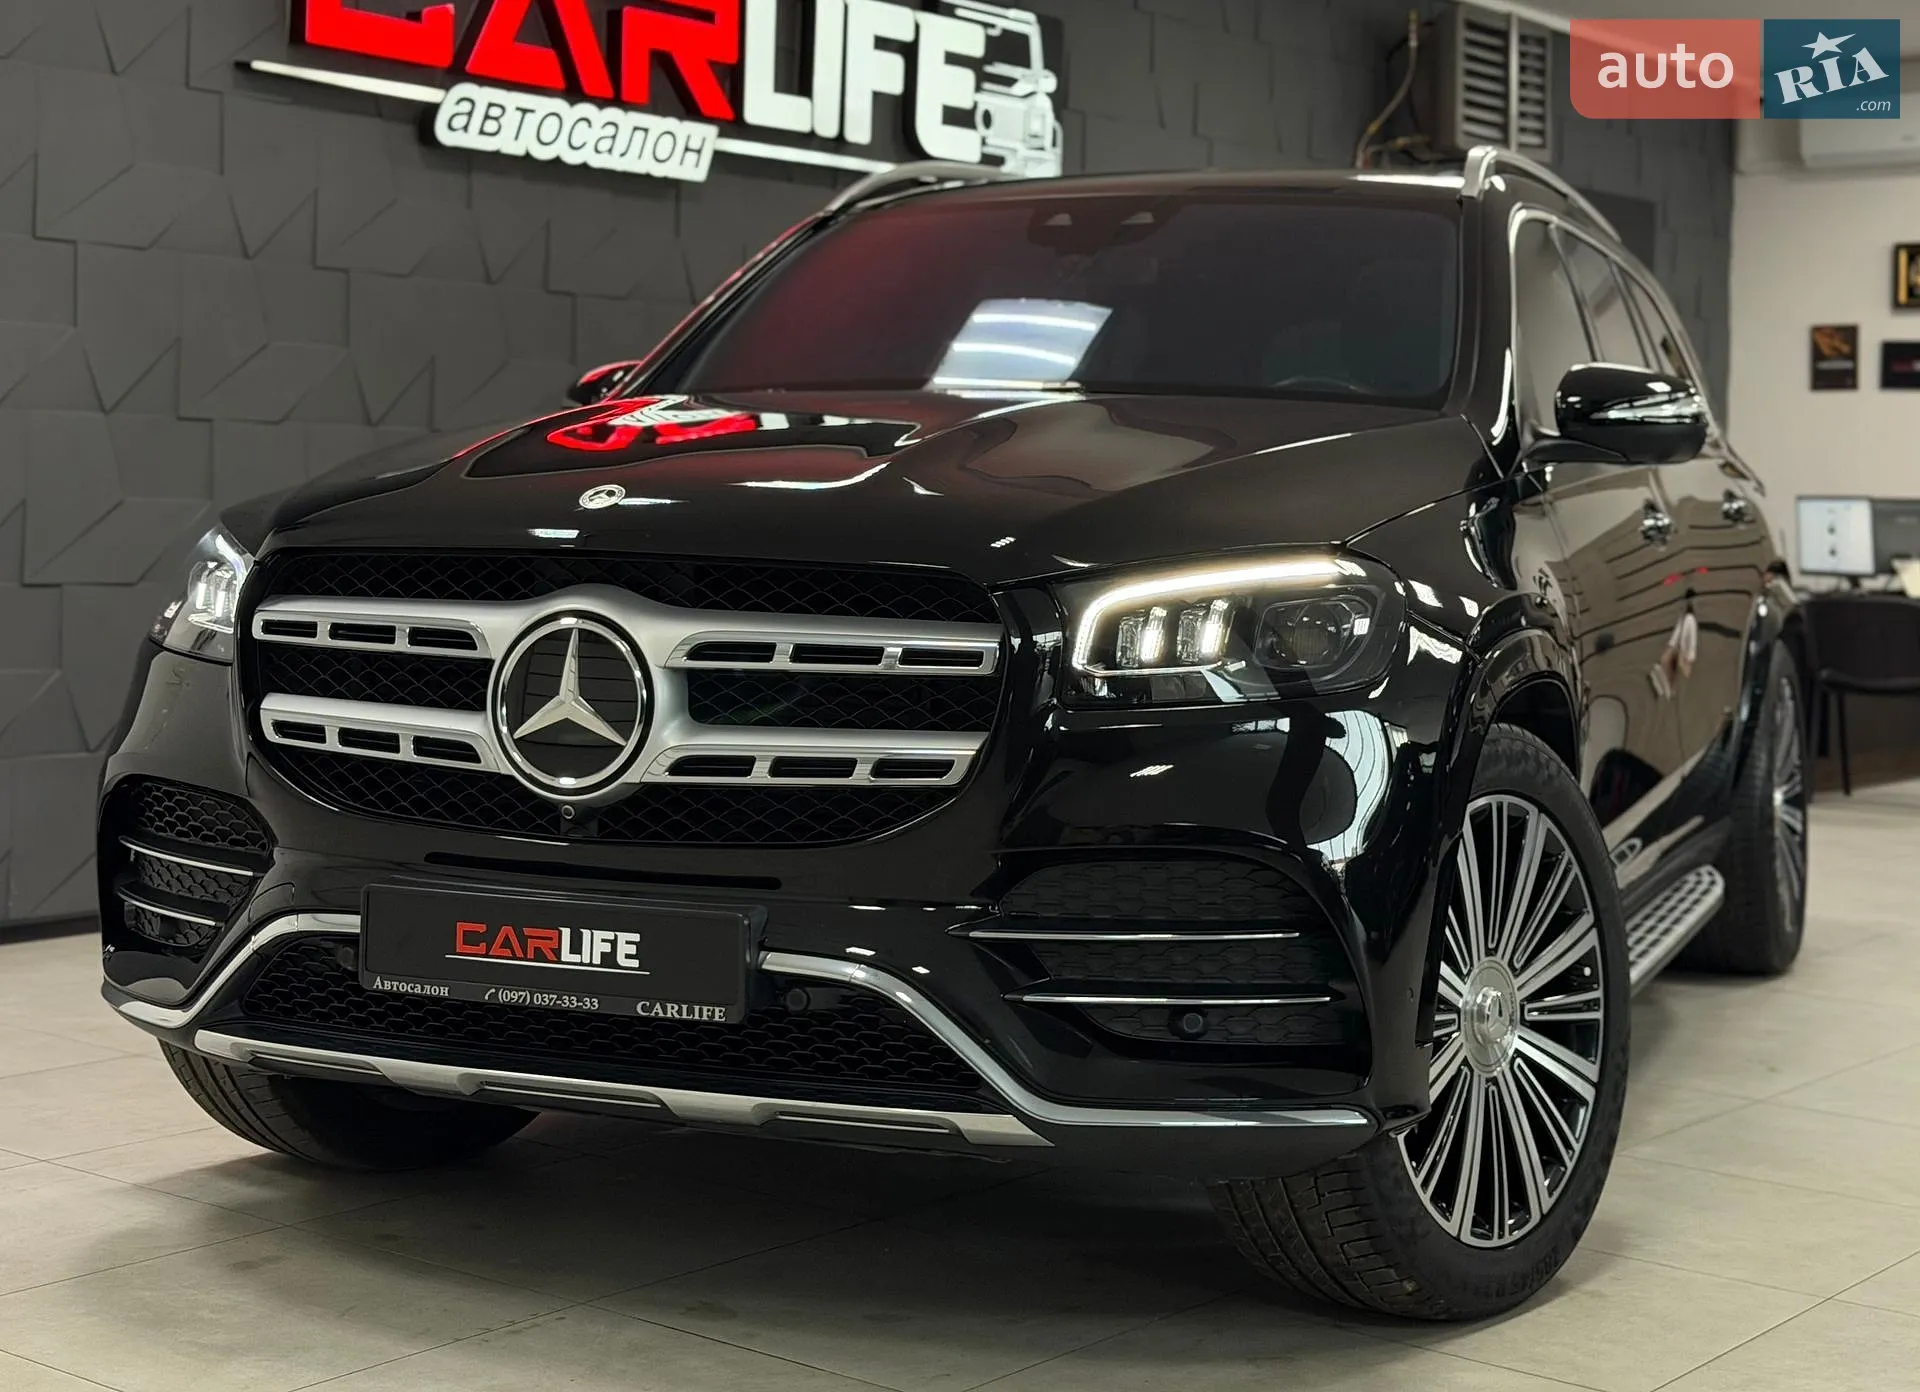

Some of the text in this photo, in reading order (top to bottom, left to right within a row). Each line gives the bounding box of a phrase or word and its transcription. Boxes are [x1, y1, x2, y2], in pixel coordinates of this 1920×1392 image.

[446, 96, 712, 169] автосалон
[456, 921, 641, 968] CARLIFE
[372, 976, 450, 997] Автосалон
[498, 988, 600, 1010] (097) 037-33-33
[635, 1000, 727, 1022] CARLIFE
